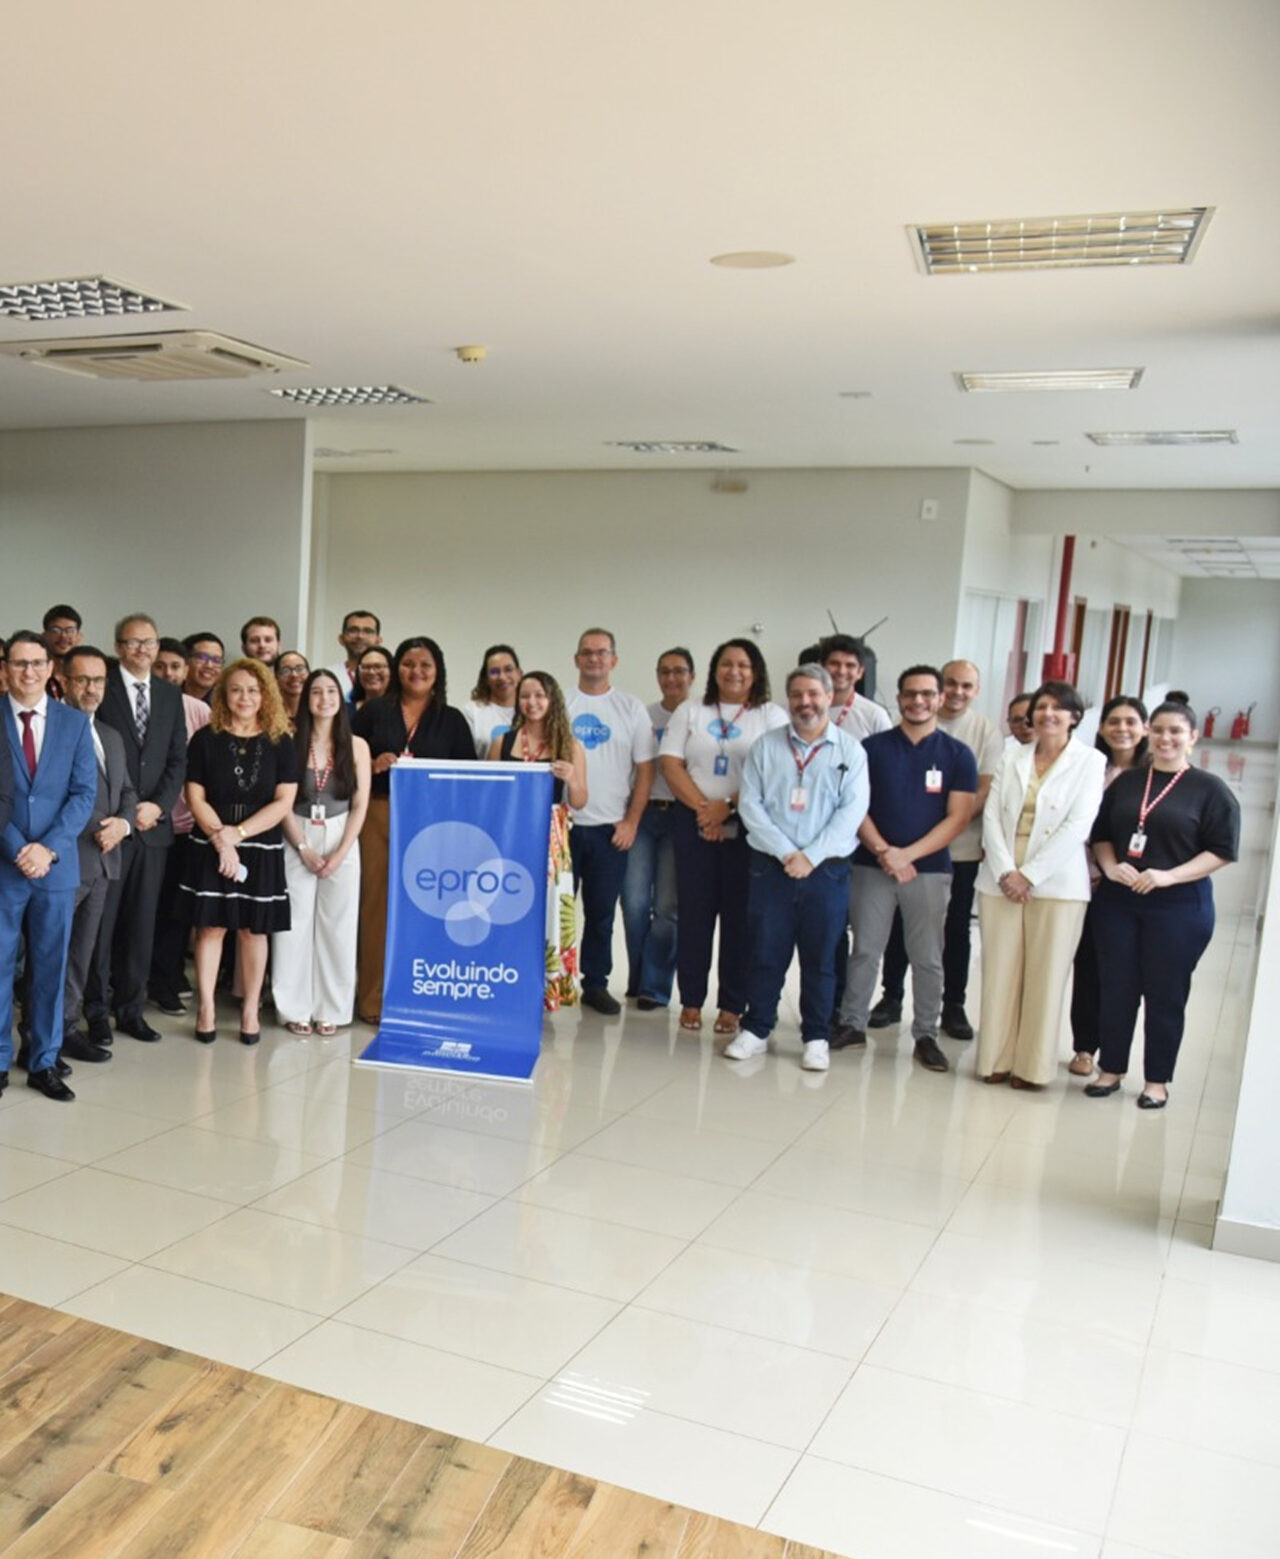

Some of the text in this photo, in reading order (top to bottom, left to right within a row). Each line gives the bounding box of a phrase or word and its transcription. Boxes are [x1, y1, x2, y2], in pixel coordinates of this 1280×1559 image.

[416, 868, 521, 900] eproc
[412, 959, 518, 984] Evoluindo
[412, 979, 495, 1000] sempre.
